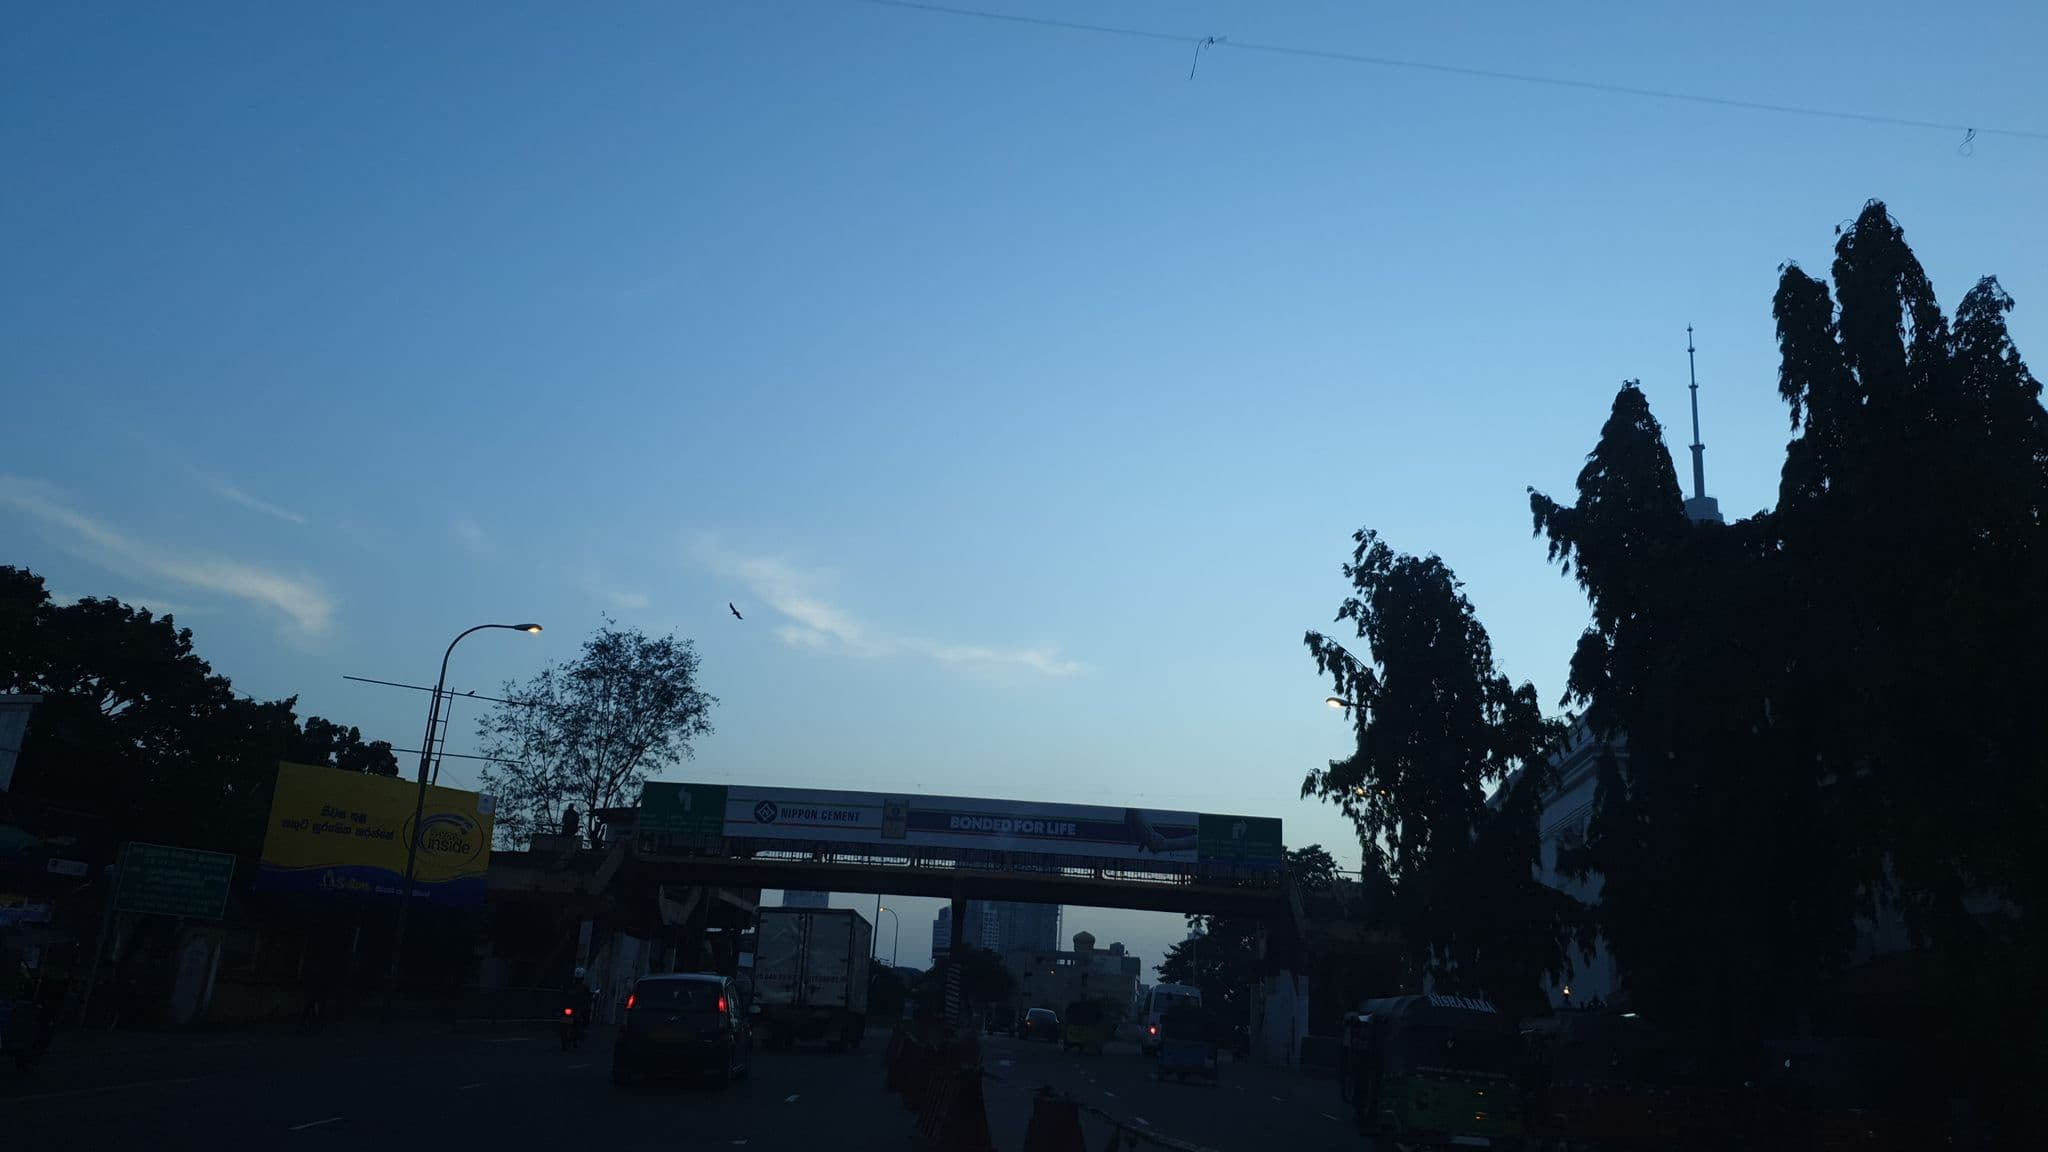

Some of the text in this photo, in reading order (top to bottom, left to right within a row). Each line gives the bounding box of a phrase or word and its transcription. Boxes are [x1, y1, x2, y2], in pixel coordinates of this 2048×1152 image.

[780, 807, 860, 822] NIPPON CEMENT
[950, 815, 1077, 836] BONDED FOR LIFE
[427, 836, 471, 855] inside
